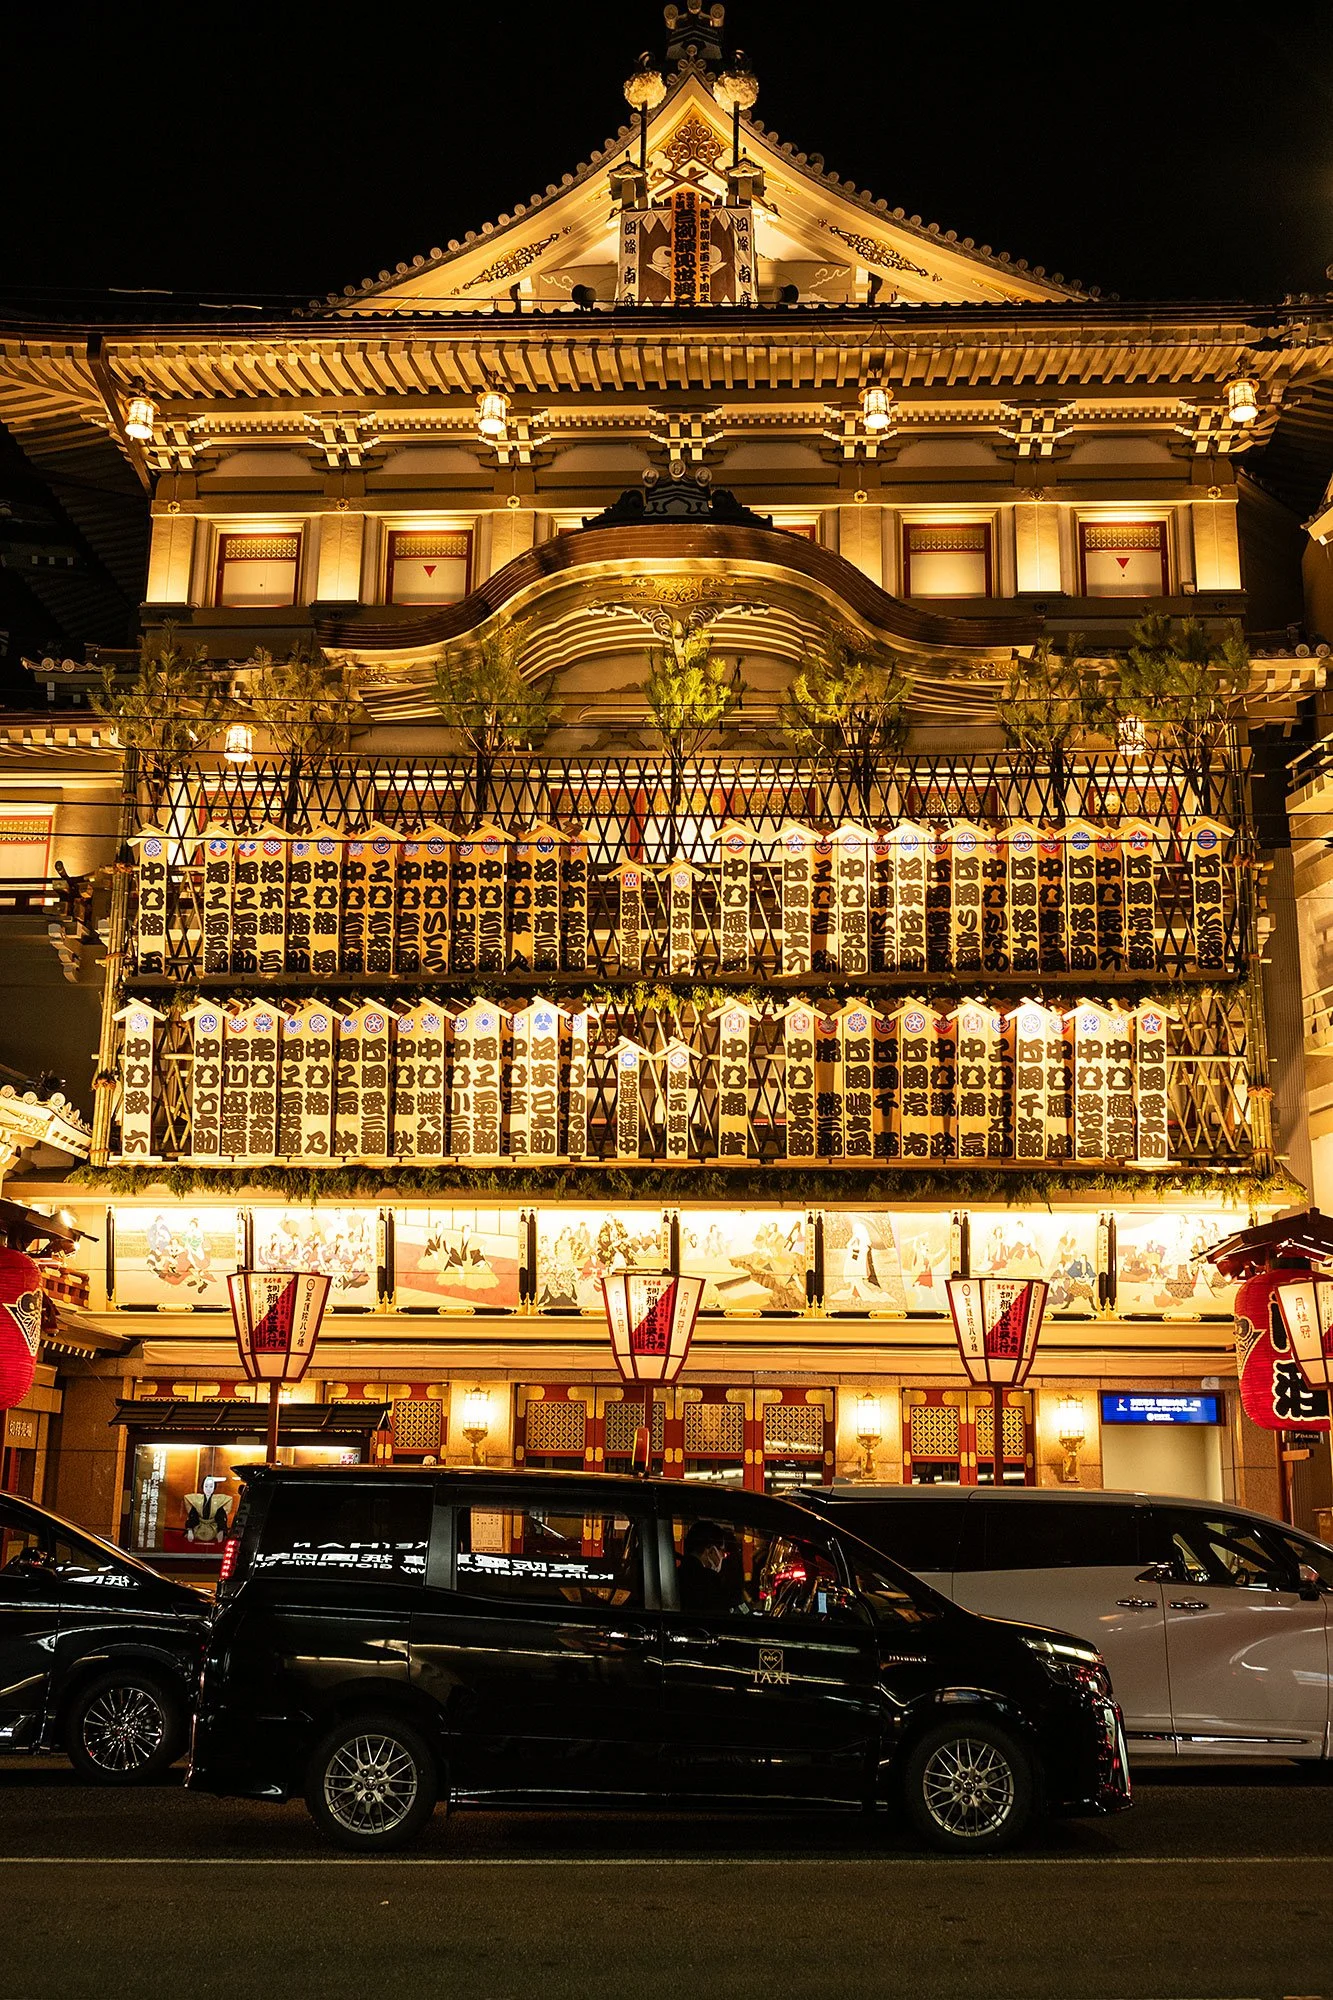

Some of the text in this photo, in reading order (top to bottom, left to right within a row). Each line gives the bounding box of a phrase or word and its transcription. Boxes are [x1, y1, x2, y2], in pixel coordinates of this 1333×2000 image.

[1295, 1297, 1311, 1339] 月桂冠
[752, 1670, 791, 1685] TAXI
